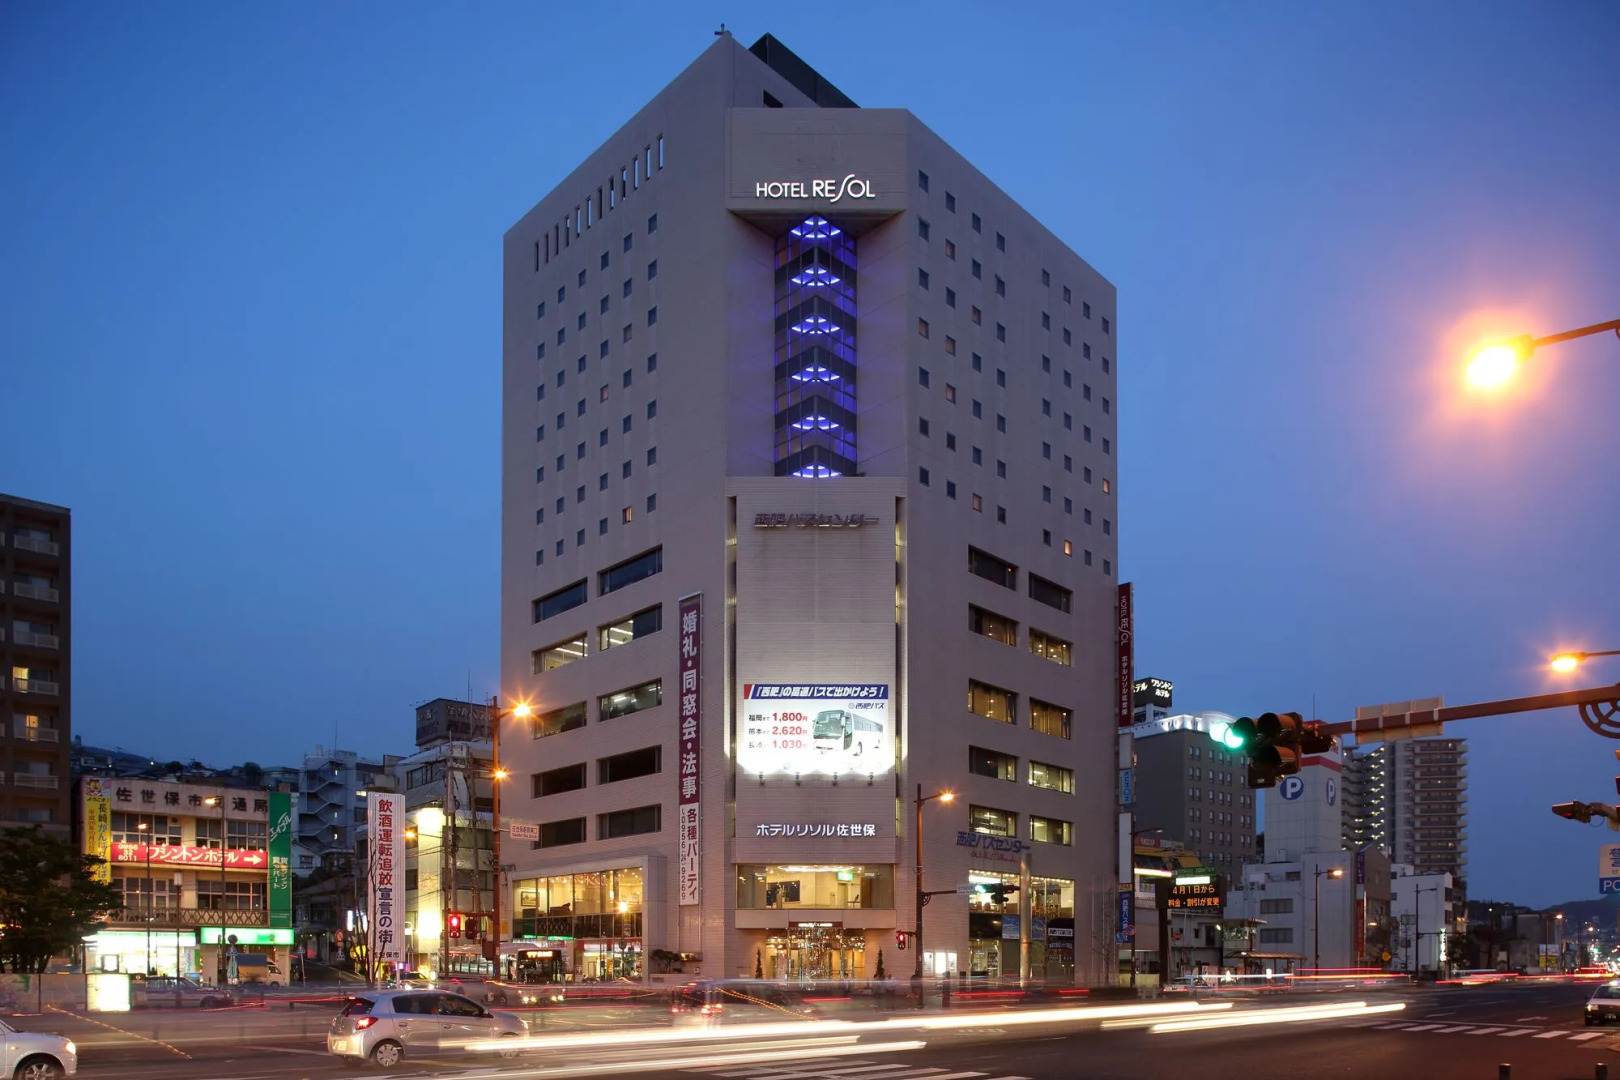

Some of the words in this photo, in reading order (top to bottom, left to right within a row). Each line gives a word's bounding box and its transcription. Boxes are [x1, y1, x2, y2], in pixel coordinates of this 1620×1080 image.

[756, 182, 808, 198] HOTEL
[812, 173, 876, 203] RESOL
[1133, 682, 1148, 693] テル
[1151, 679, 1173, 690] ワシントン
[1155, 689, 1170, 698] ホテル
[682, 610, 697, 798] 婚礼・同窓会・法事
[1286, 778, 1301, 798] P
[756, 824, 876, 837] ホテルリソル佐世保
[956, 831, 1031, 853] 西肥バスセンター
[118, 854, 137, 862] 8011
[687, 808, 697, 900] 各種パーティ
